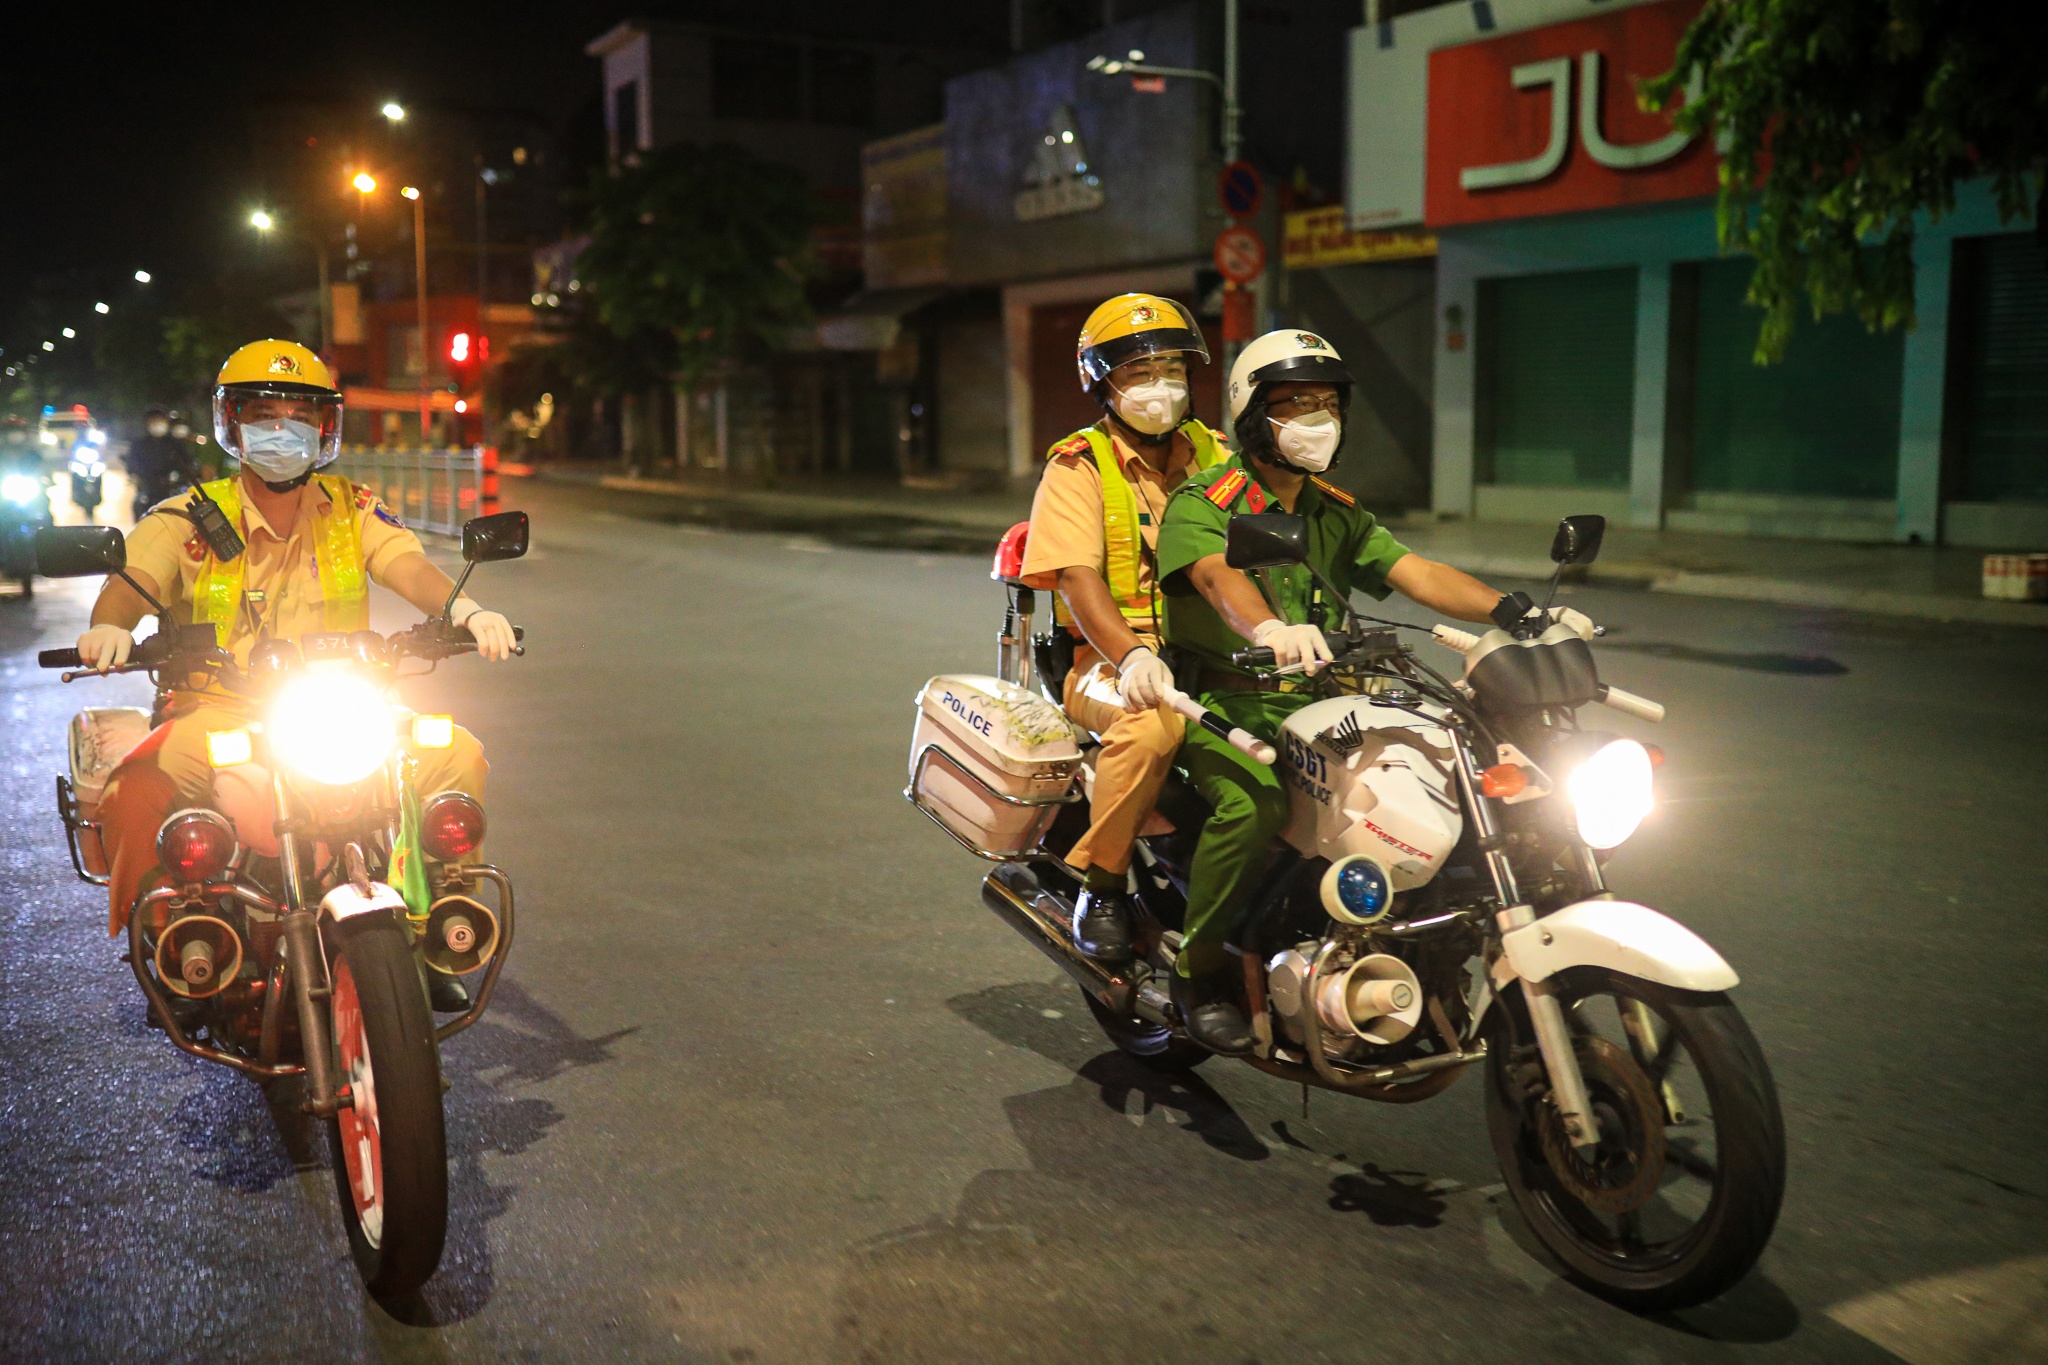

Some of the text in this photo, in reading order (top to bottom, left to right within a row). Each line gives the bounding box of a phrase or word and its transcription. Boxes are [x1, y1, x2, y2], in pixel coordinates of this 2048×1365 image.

[1459, 42, 1735, 190] JU
[942, 691, 993, 737] POLICE
[1286, 730, 1326, 784] CSGT
[1314, 731, 1348, 760] HONDA
